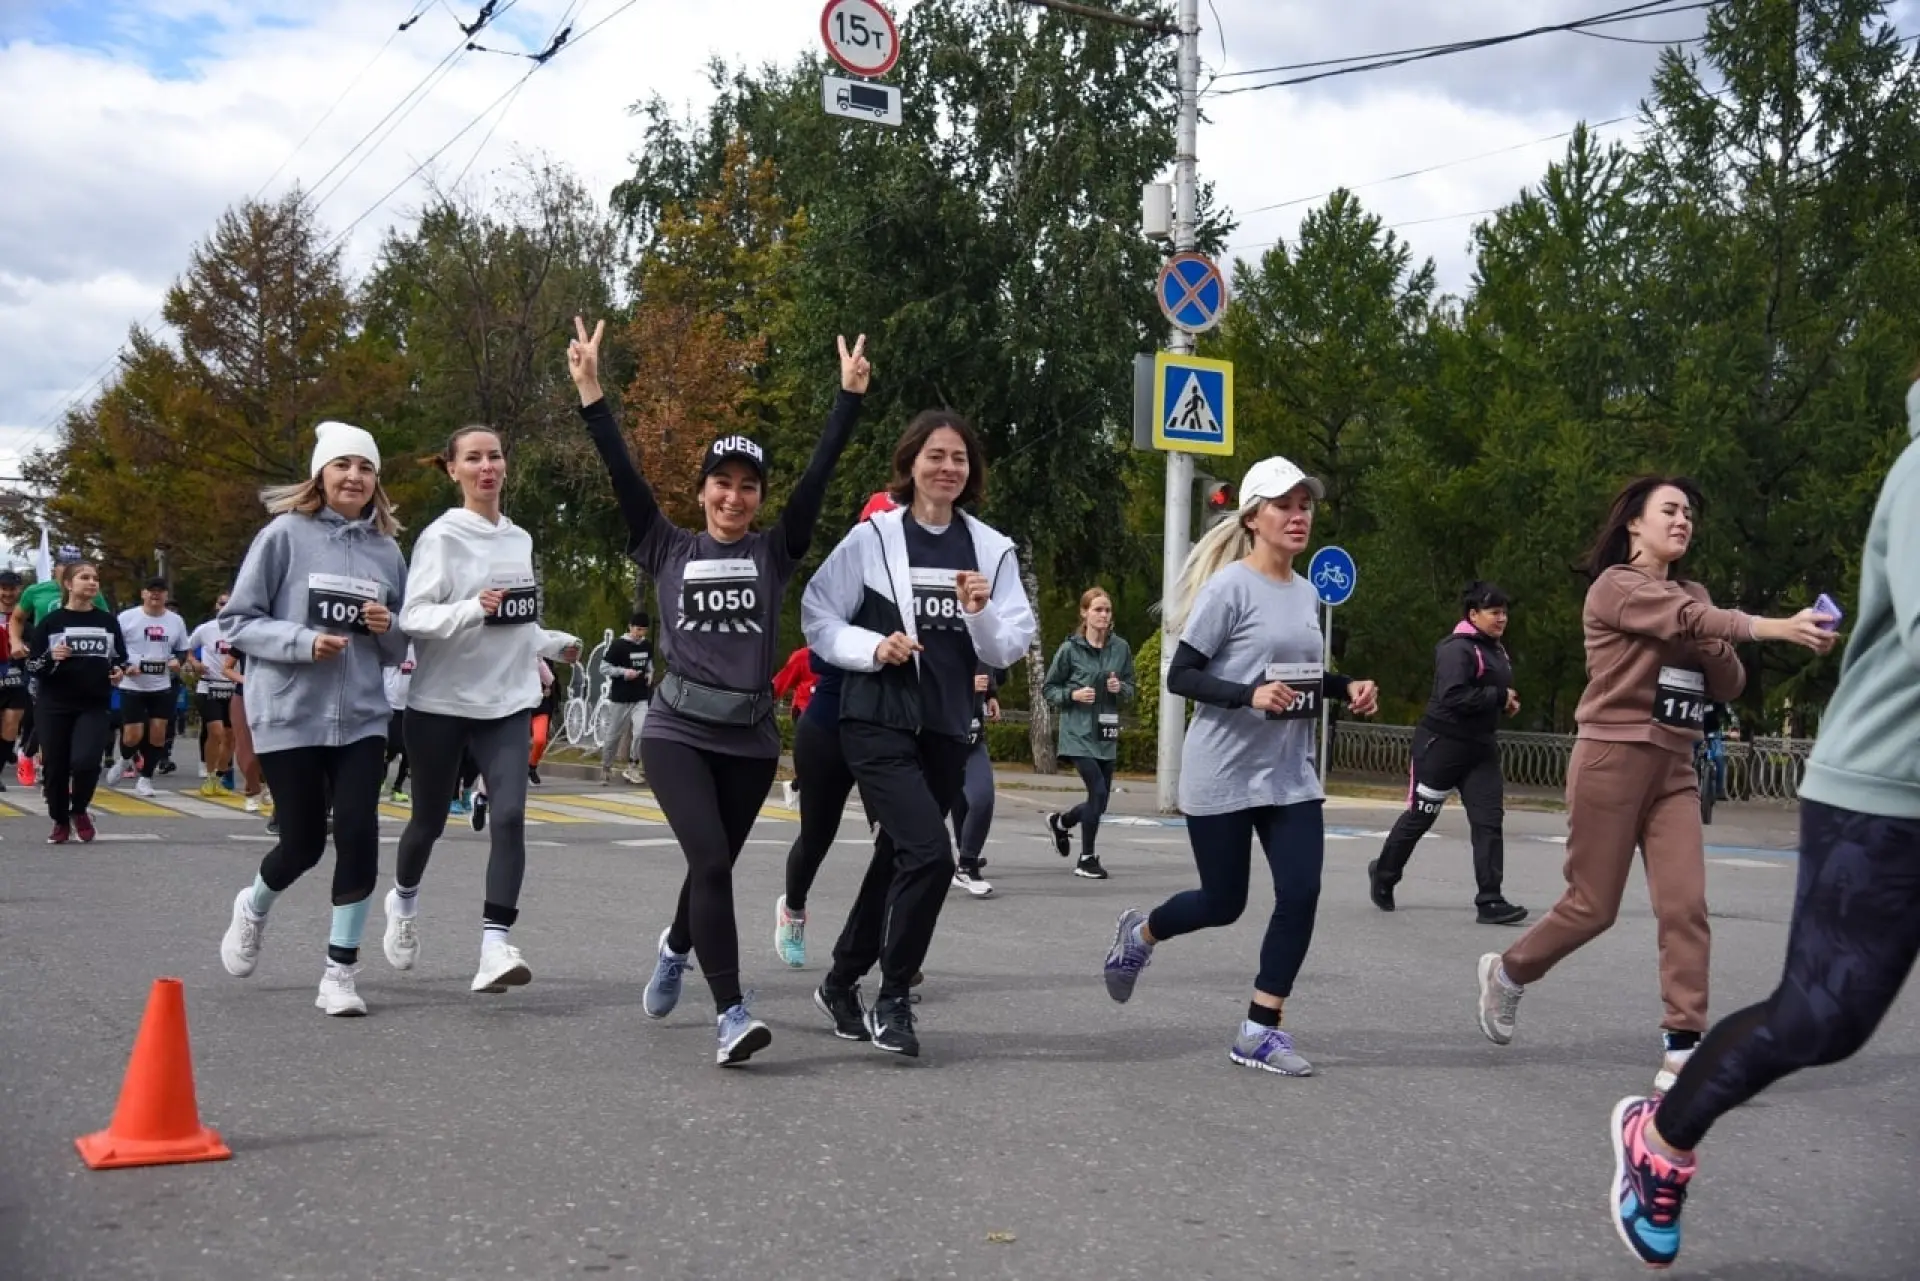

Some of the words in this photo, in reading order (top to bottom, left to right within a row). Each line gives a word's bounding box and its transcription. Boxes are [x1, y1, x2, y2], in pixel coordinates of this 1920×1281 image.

[713, 435, 763, 463] QUEEN
[497, 597, 535, 618] 1089
[692, 588, 756, 612] 1050
[71, 640, 105, 651] 1076
